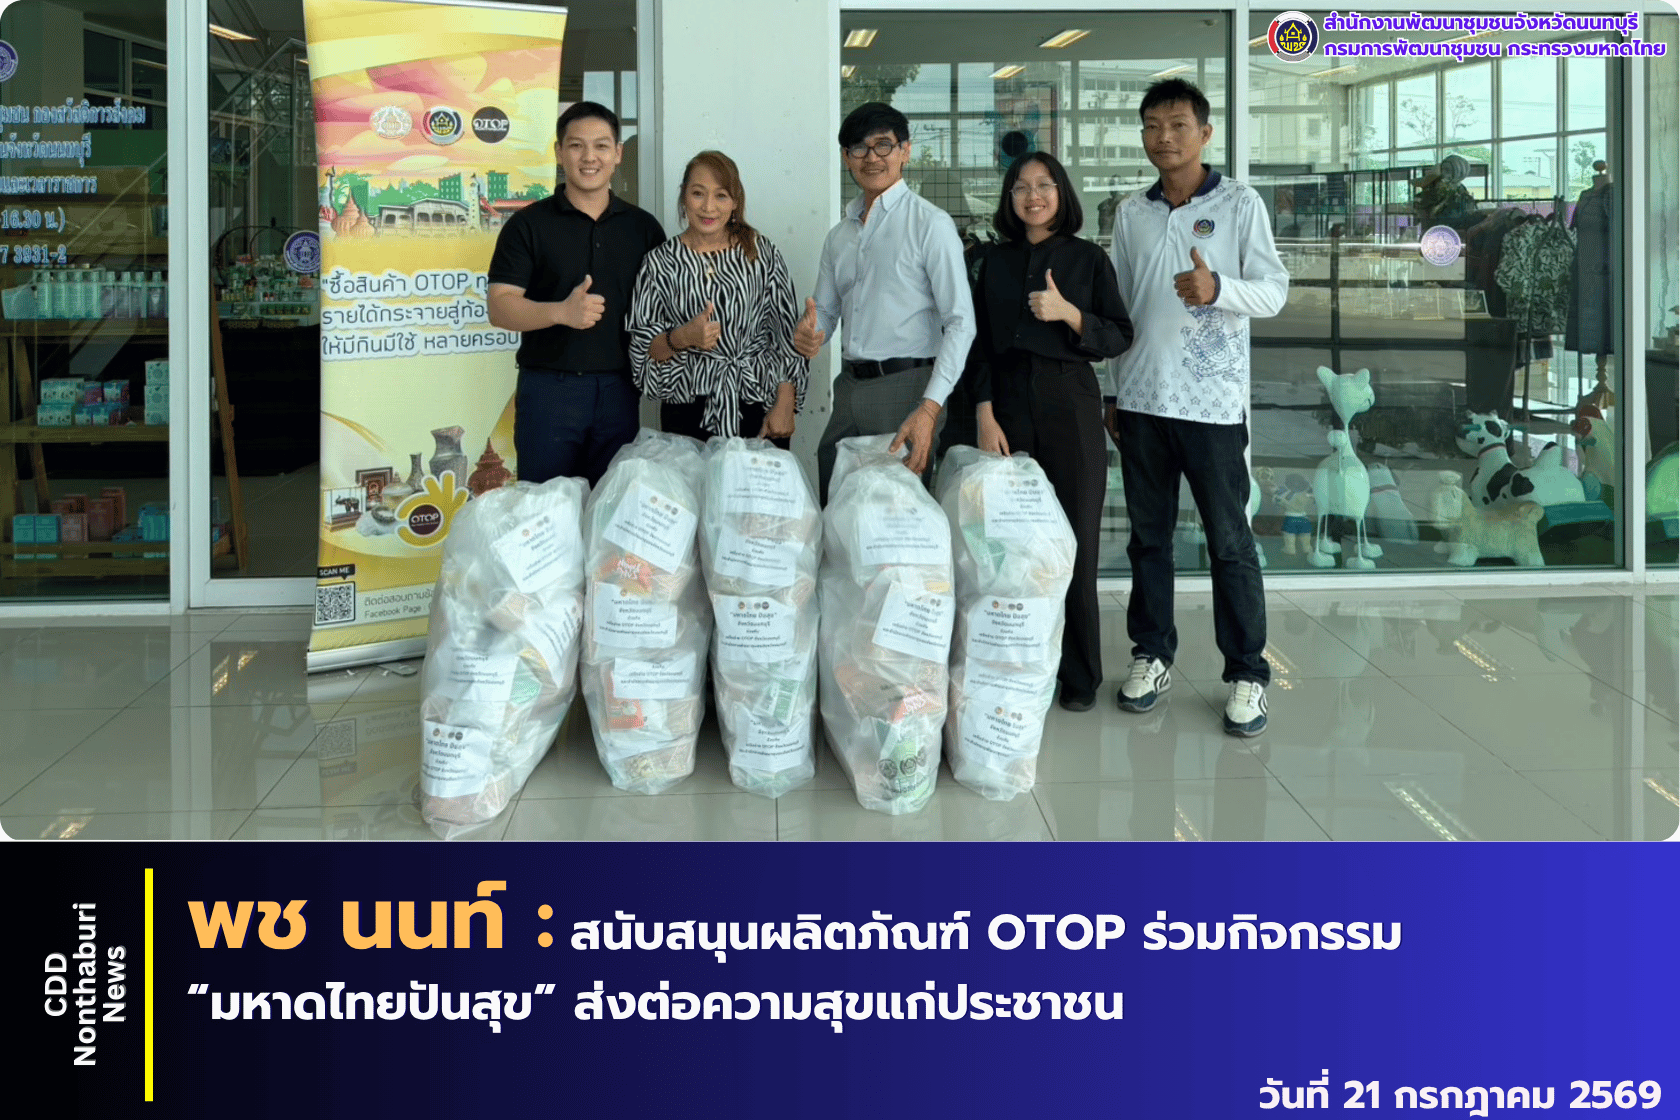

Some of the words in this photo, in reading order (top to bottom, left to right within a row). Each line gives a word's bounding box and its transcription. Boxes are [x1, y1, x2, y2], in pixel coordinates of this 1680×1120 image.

[33, 97, 146, 124] กองสวัสดิการสังคม
[473, 118, 509, 129] OTOP
[13, 244, 67, 264] 3931-2
[415, 273, 468, 291] OTOP
[322, 300, 489, 325] รายได้กระจายสู่ท้อ
[321, 331, 418, 355] ให้มีกินมีใช้
[424, 331, 519, 350] หลายครอบ
[411, 512, 439, 522] OTOP
[319, 568, 338, 576] SCAN
[364, 607, 400, 619] Facebook
[402, 604, 422, 614] Page
